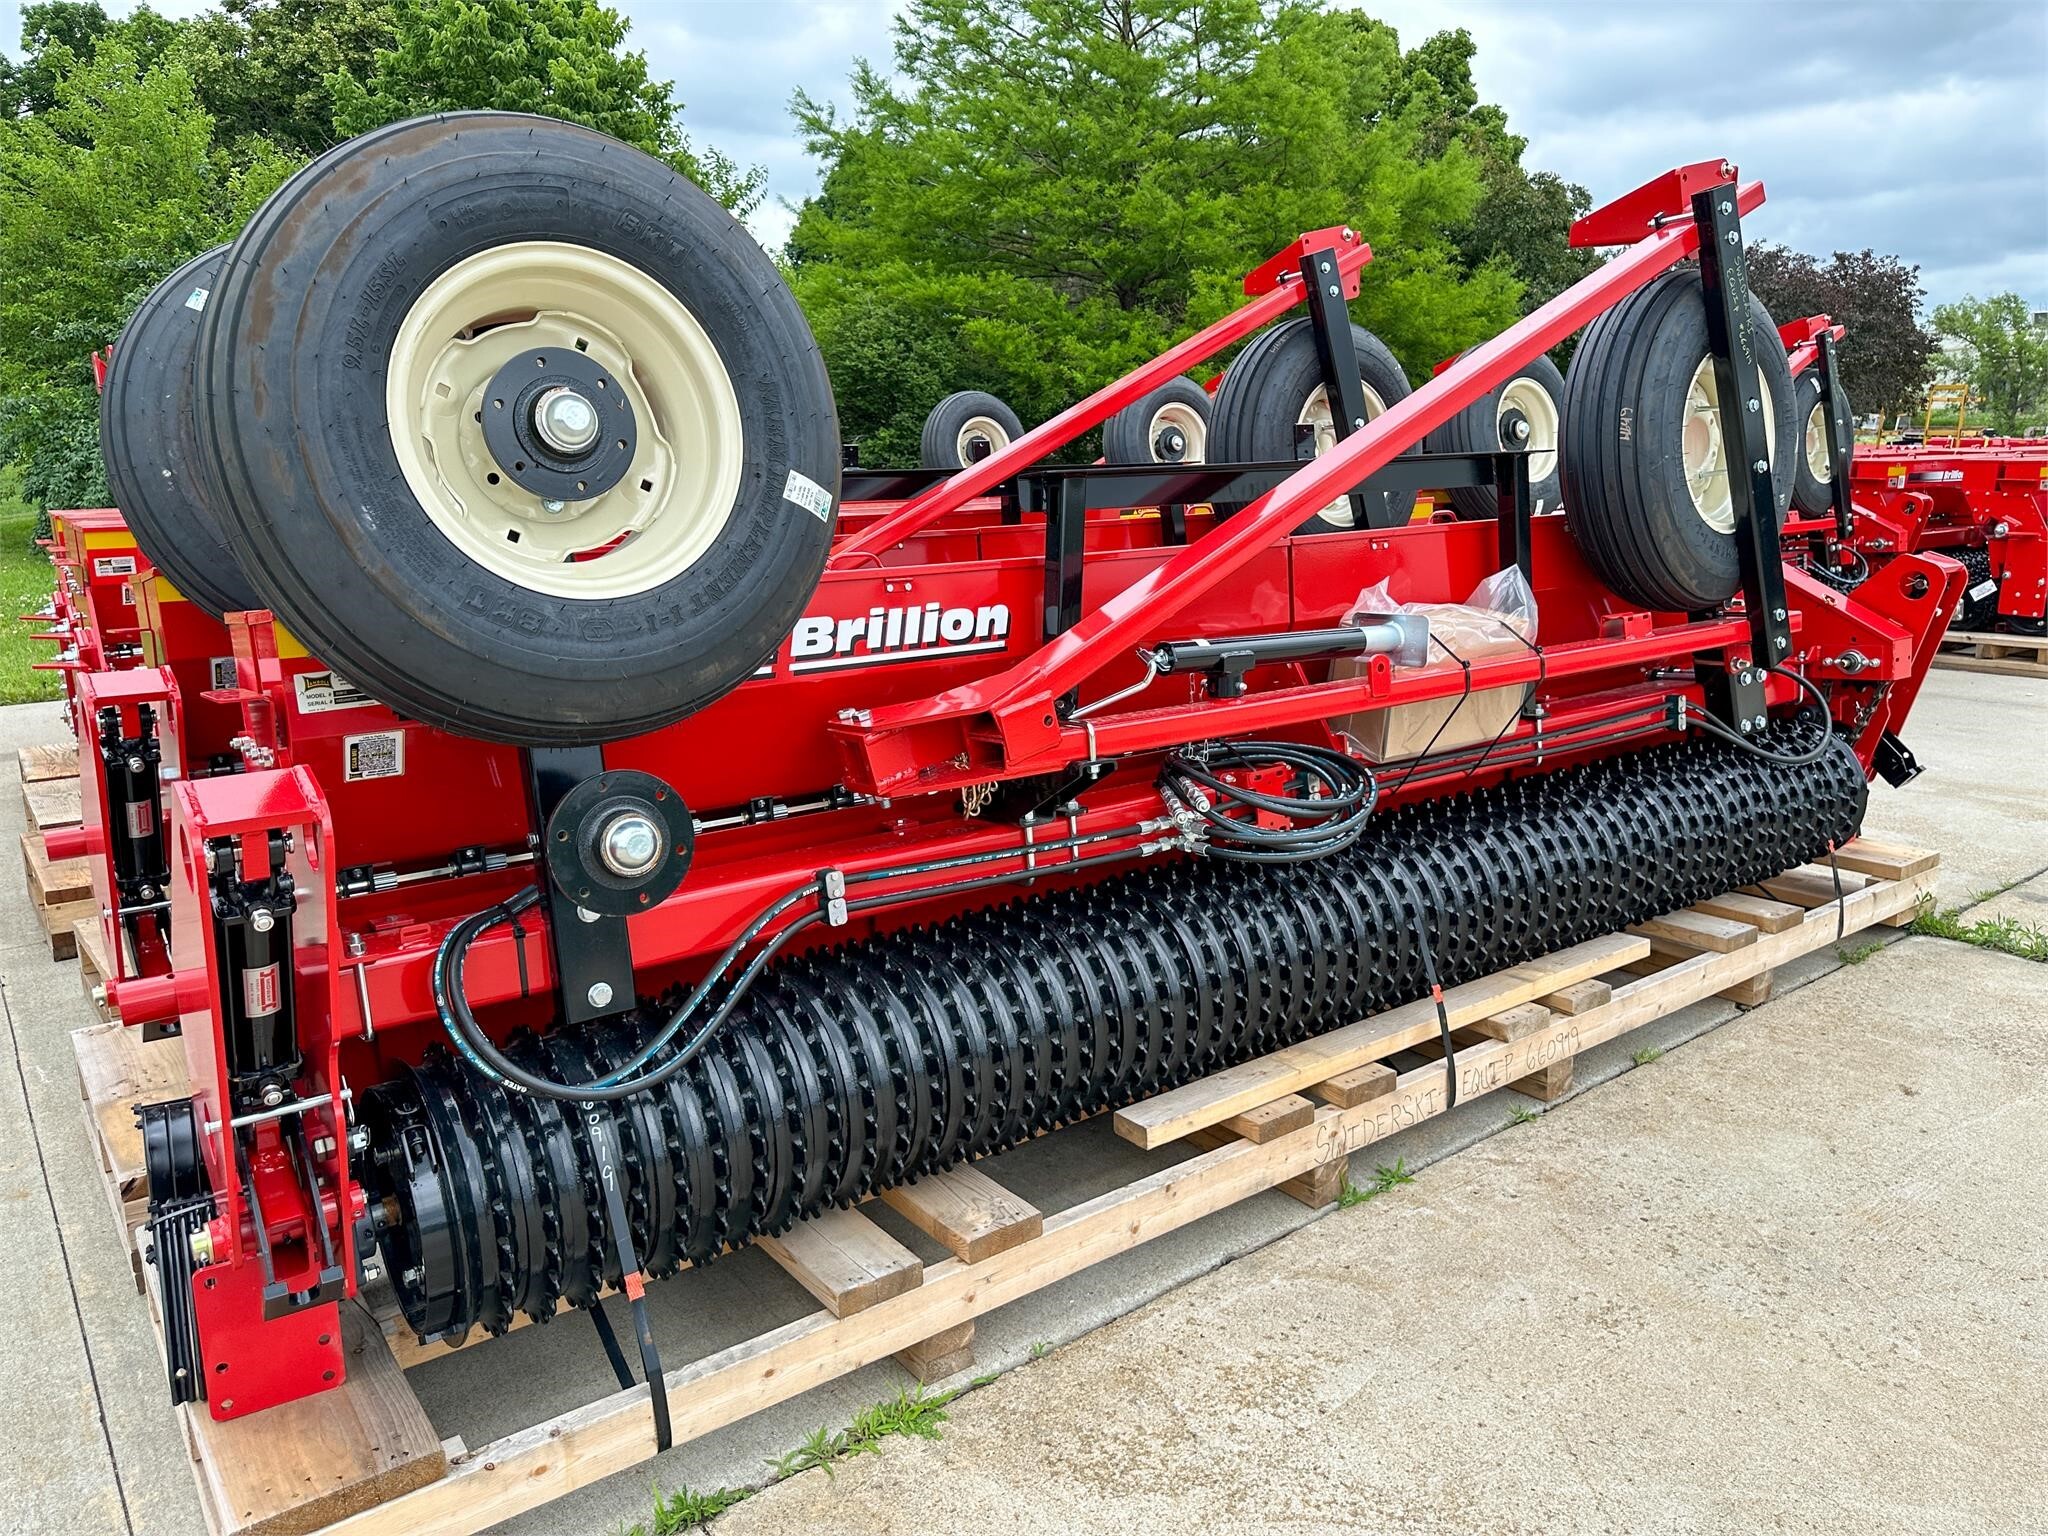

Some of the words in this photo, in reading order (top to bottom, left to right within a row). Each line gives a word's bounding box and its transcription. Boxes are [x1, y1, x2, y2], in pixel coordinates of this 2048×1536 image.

[615, 211, 691, 264] BKT
[463, 587, 546, 635] BKT
[790, 602, 1010, 658] Brillion
[307, 699, 329, 707] SERIAL
